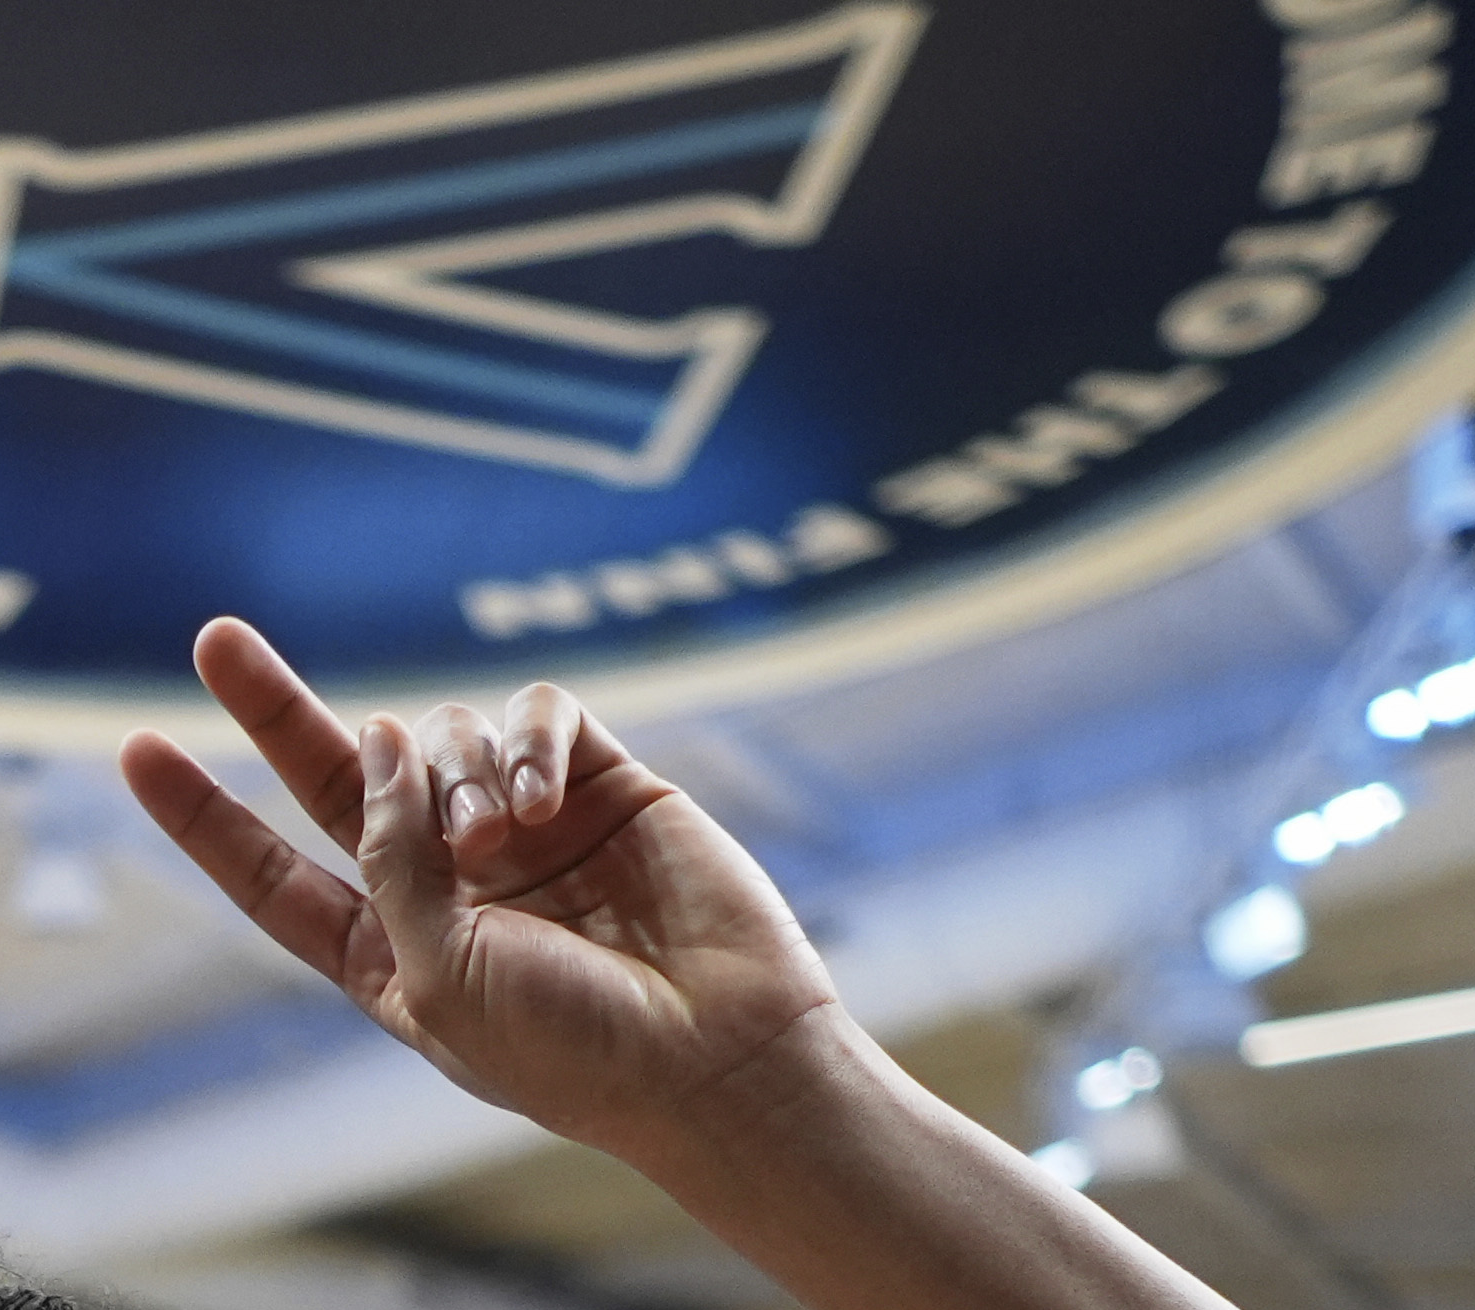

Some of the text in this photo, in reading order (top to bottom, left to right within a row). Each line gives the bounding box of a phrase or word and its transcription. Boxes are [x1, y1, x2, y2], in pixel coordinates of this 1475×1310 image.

[1155, 196, 1402, 358] TO
[868, 358, 1234, 530] THE
[458, 502, 898, 642] FINN
